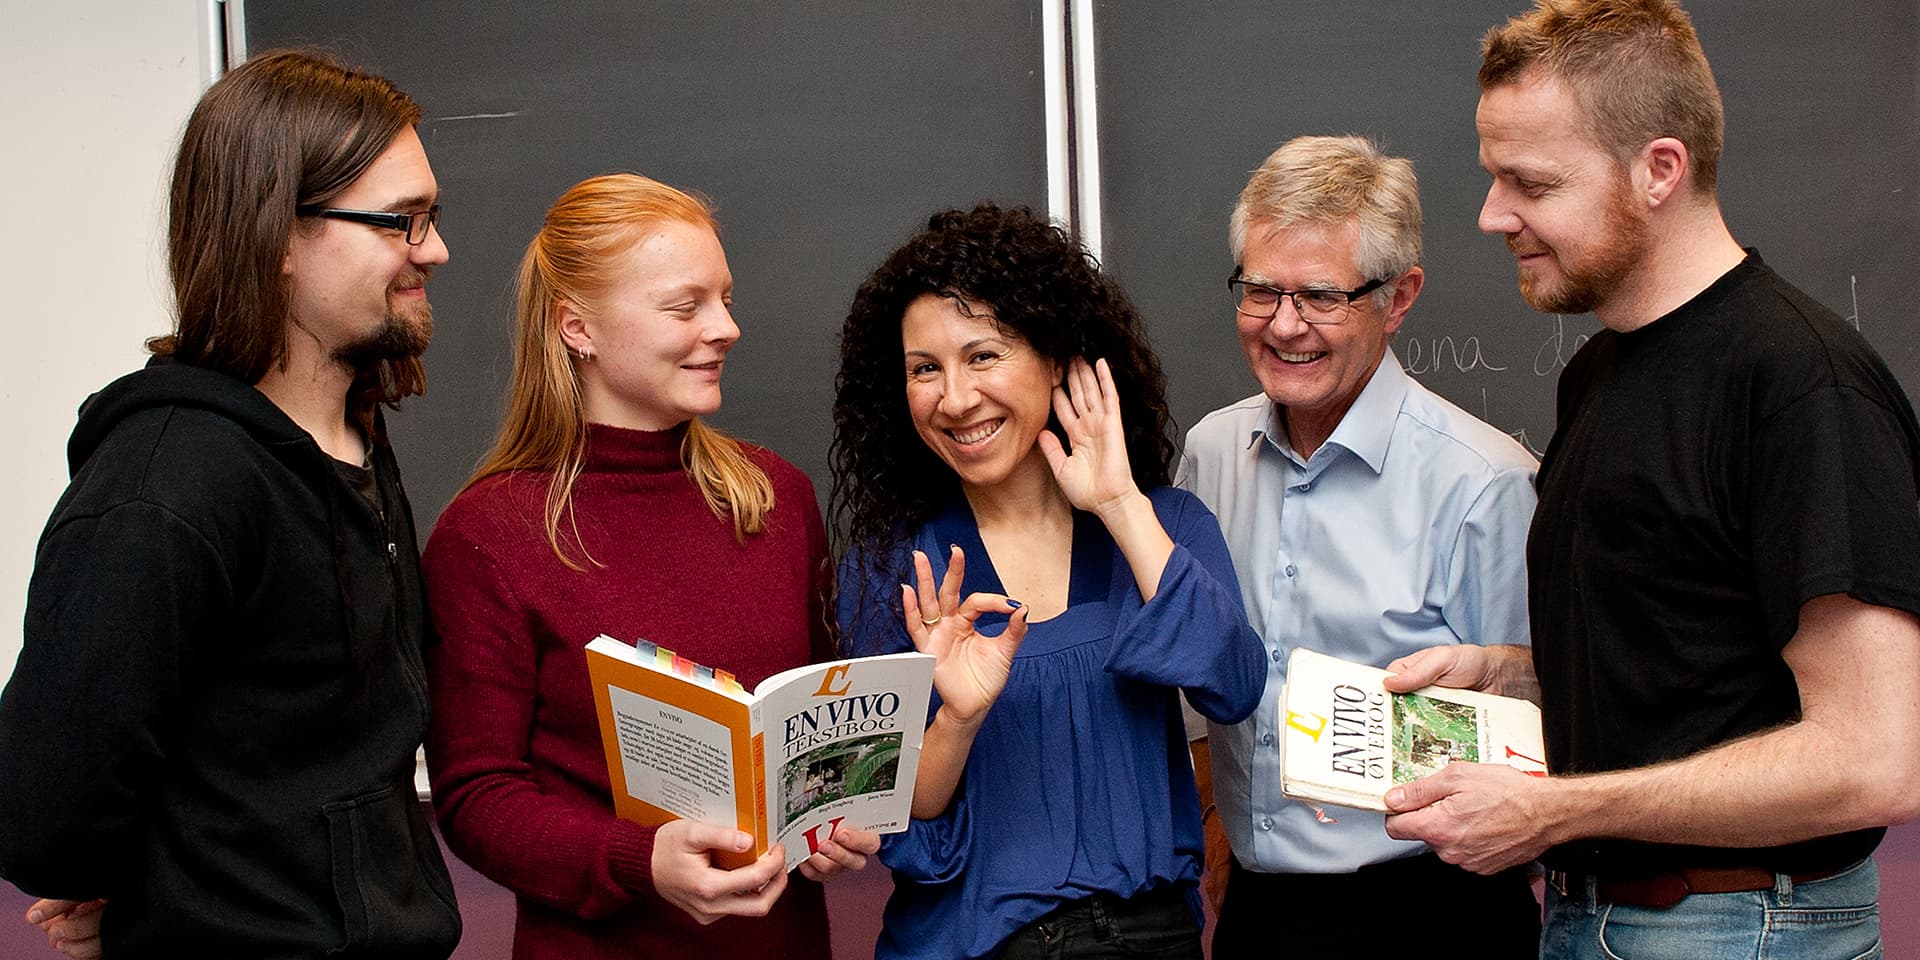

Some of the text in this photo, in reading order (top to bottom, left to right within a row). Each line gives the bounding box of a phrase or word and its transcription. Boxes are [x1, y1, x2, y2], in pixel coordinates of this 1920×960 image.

[783, 717, 895, 758] TEKSTBOG
[784, 705, 822, 746] EN
[826, 692, 900, 726] VIVO
[1332, 684, 1367, 779] EN VIVO
[1368, 692, 1385, 780] ØVEBOG
